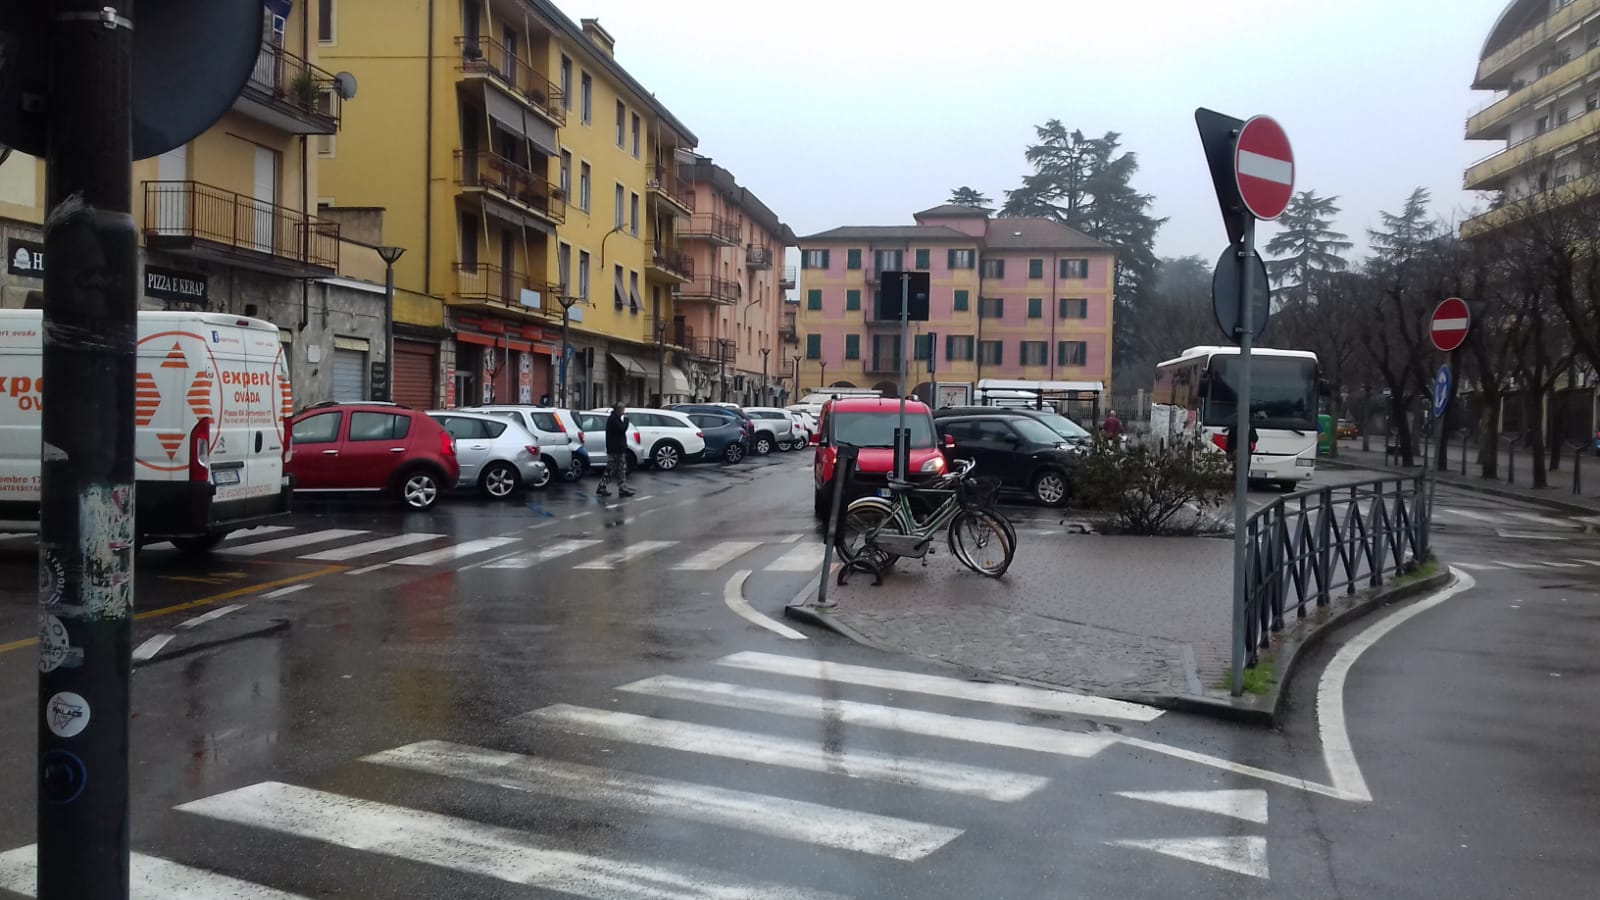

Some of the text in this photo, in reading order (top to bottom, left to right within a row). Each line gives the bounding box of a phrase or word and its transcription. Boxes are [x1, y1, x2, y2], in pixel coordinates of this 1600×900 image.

[147, 273, 204, 296] PIZZA E KEBAP
[222, 371, 271, 388] expert
[234, 391, 261, 403] OVADA
